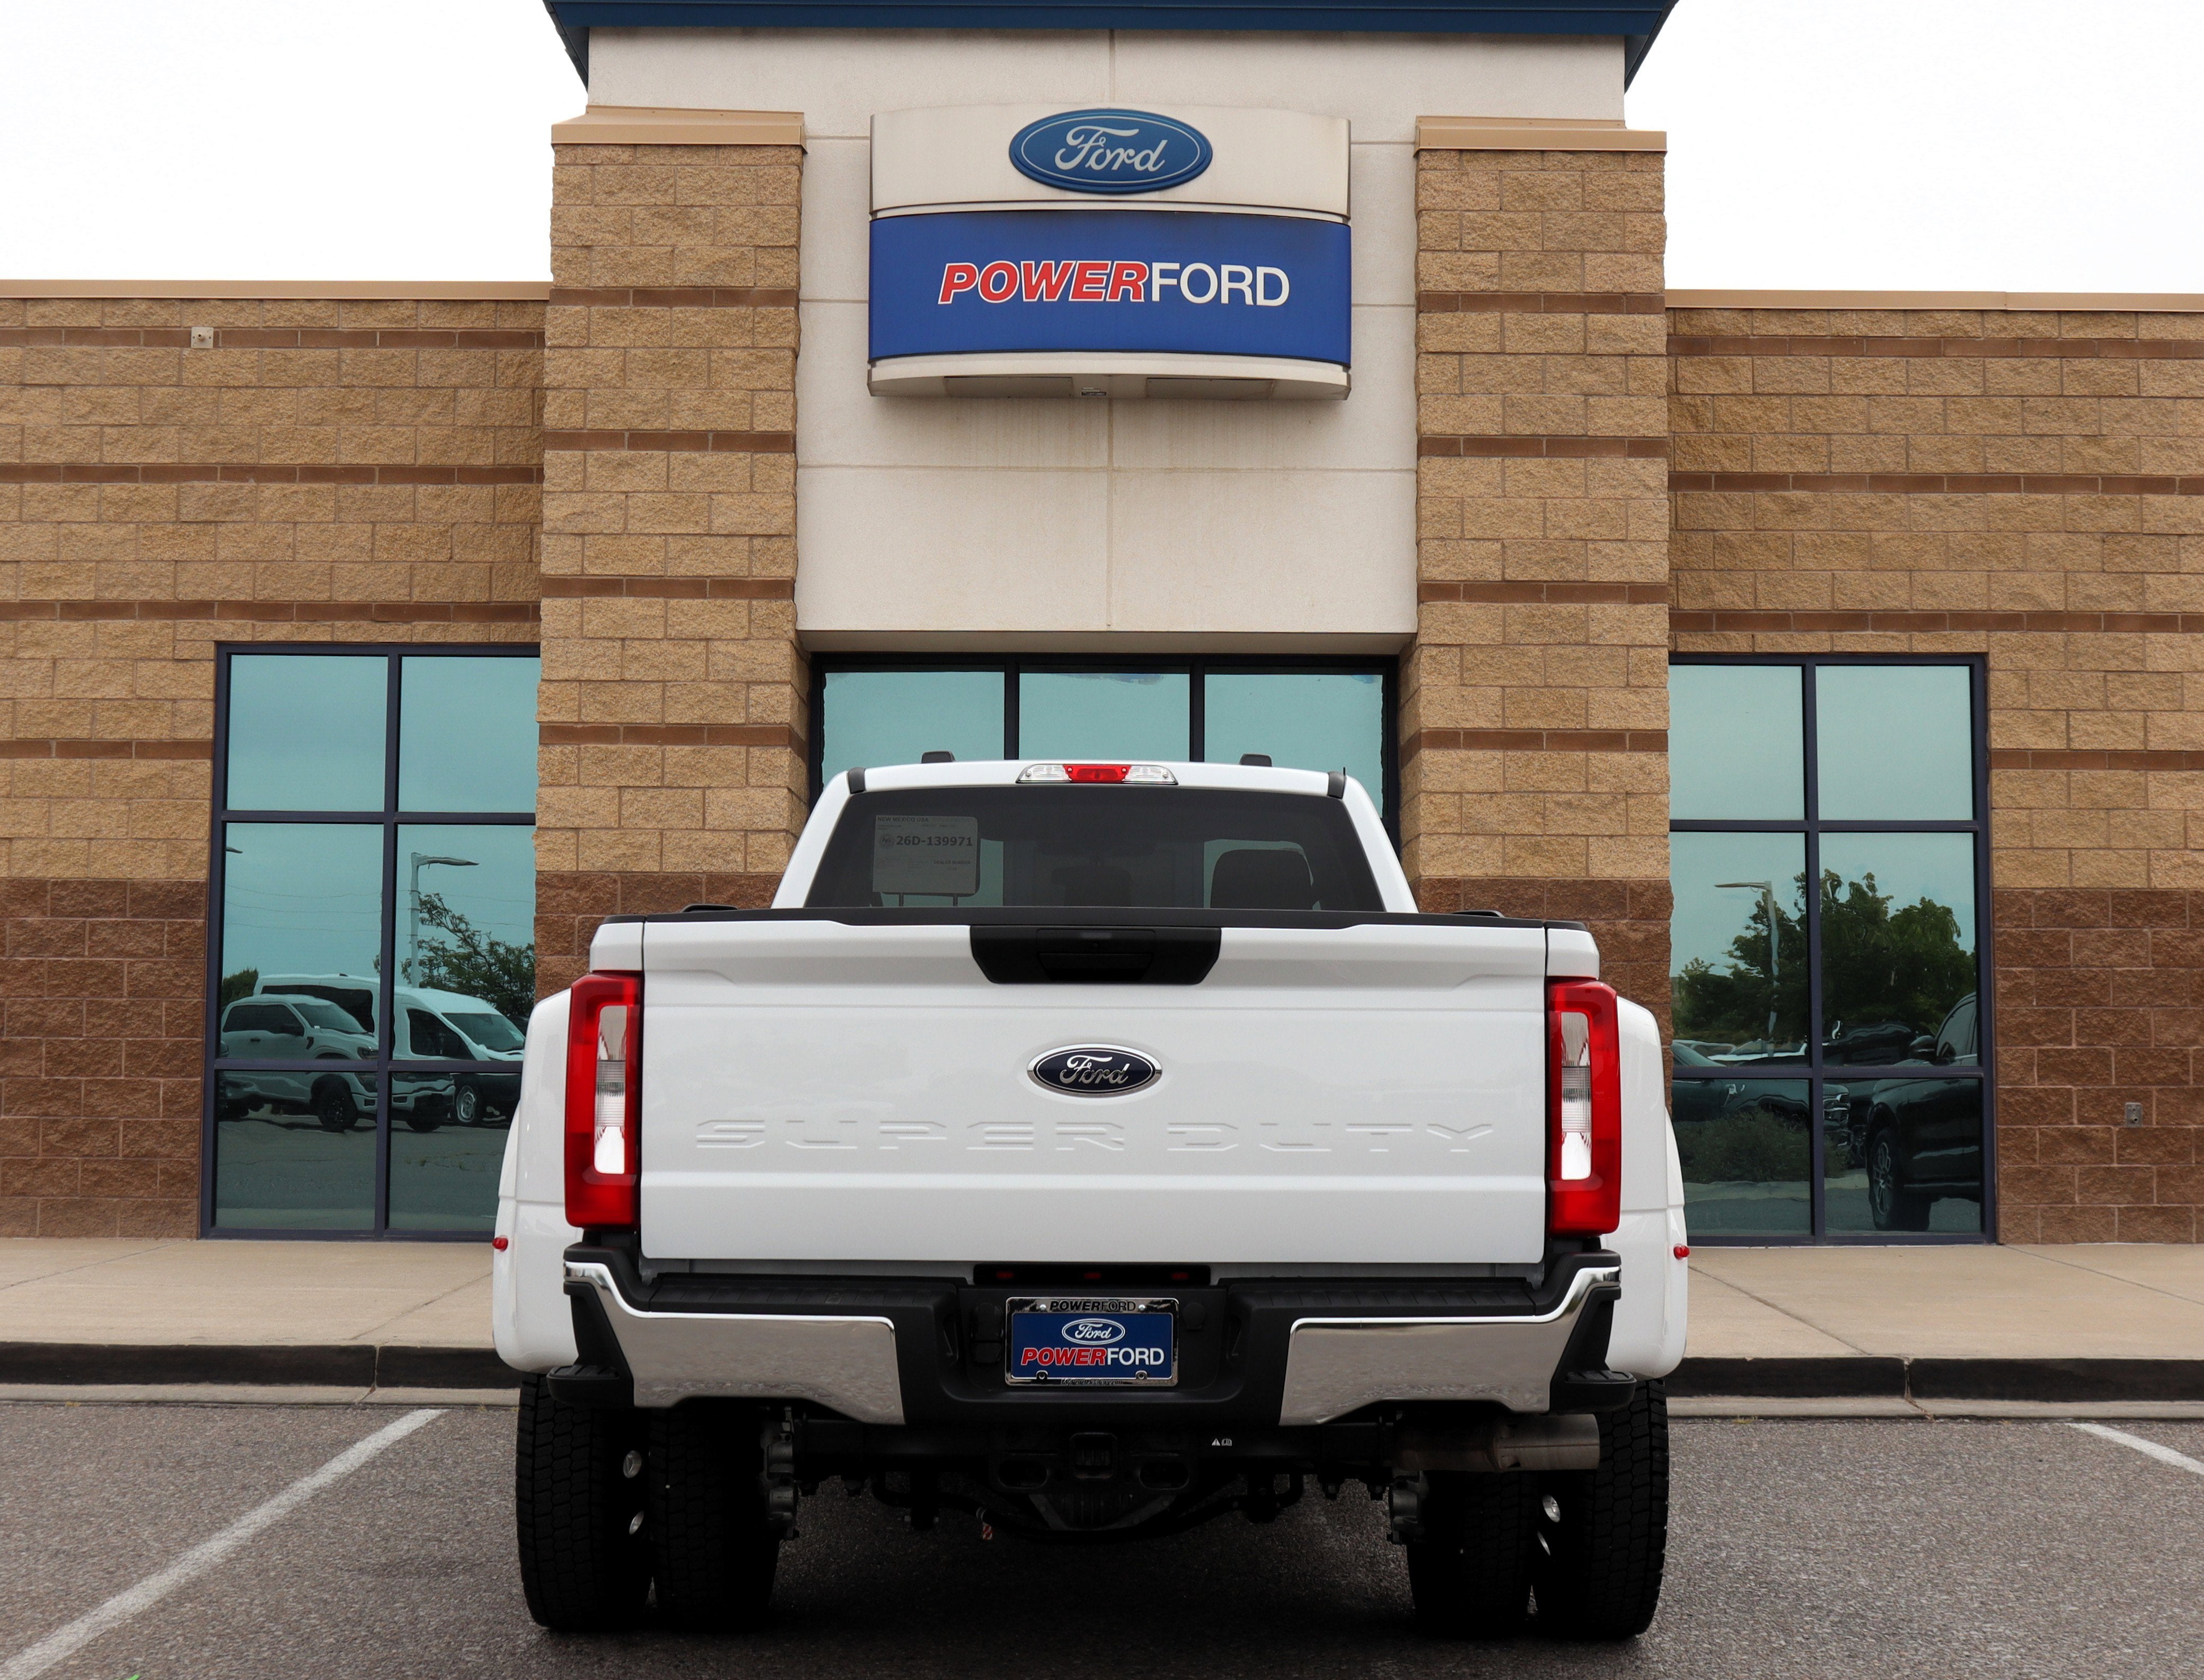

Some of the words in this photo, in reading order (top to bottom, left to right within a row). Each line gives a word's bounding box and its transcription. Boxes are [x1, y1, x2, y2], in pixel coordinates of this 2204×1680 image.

[1054, 125, 1168, 172] Ford
[896, 835, 973, 847] 26D-139971
[1060, 1055, 1130, 1084] Ford
[695, 1120, 1125, 1151] SUPER
[1167, 1123, 1494, 1153] DUTY
[1074, 1323, 1112, 1339] Ford
